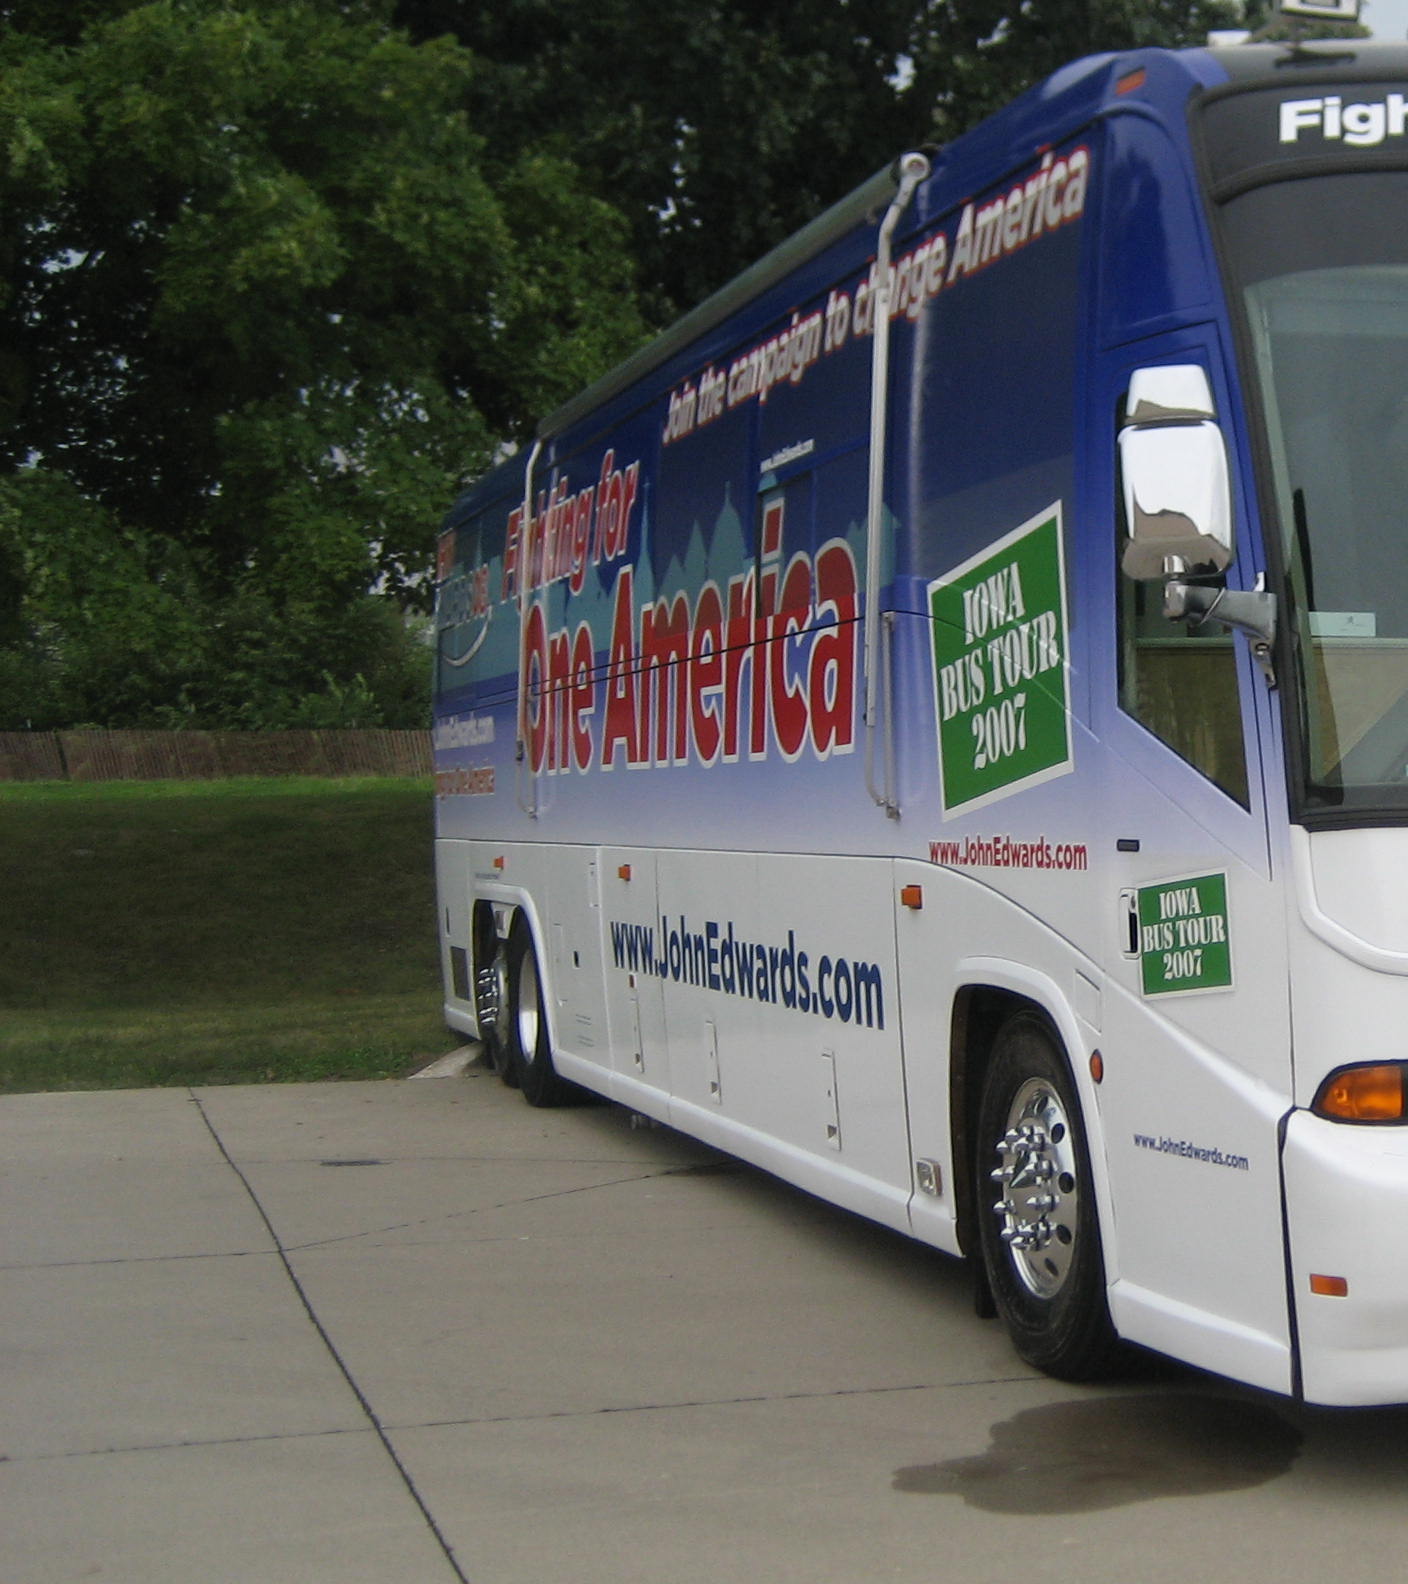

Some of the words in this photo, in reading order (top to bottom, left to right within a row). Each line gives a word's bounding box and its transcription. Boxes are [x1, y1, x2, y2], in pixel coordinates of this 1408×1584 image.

[662, 378, 697, 446] Join
[697, 361, 726, 427] the
[727, 306, 823, 410] campaign
[824, 288, 851, 356] to
[945, 146, 1091, 286] America
[592, 449, 640, 566] for
[521, 600, 595, 777] One
[600, 498, 858, 772] America
[962, 561, 1026, 646] IOWA
[940, 647, 987, 721] BUS
[987, 610, 1060, 696] TOUR
[971, 692, 1027, 771] 2007
[929, 836, 1087, 871] www.JohnEdwards.com
[1142, 922, 1174, 953] BUS
[1175, 914, 1226, 948] TOUR
[1159, 887, 1202, 921] IOWA
[610, 915, 885, 1031] www.JohnEdwards.com
[1163, 949, 1204, 980] 2007
[1133, 1131, 1249, 1171] www.JohnEdwards.com
